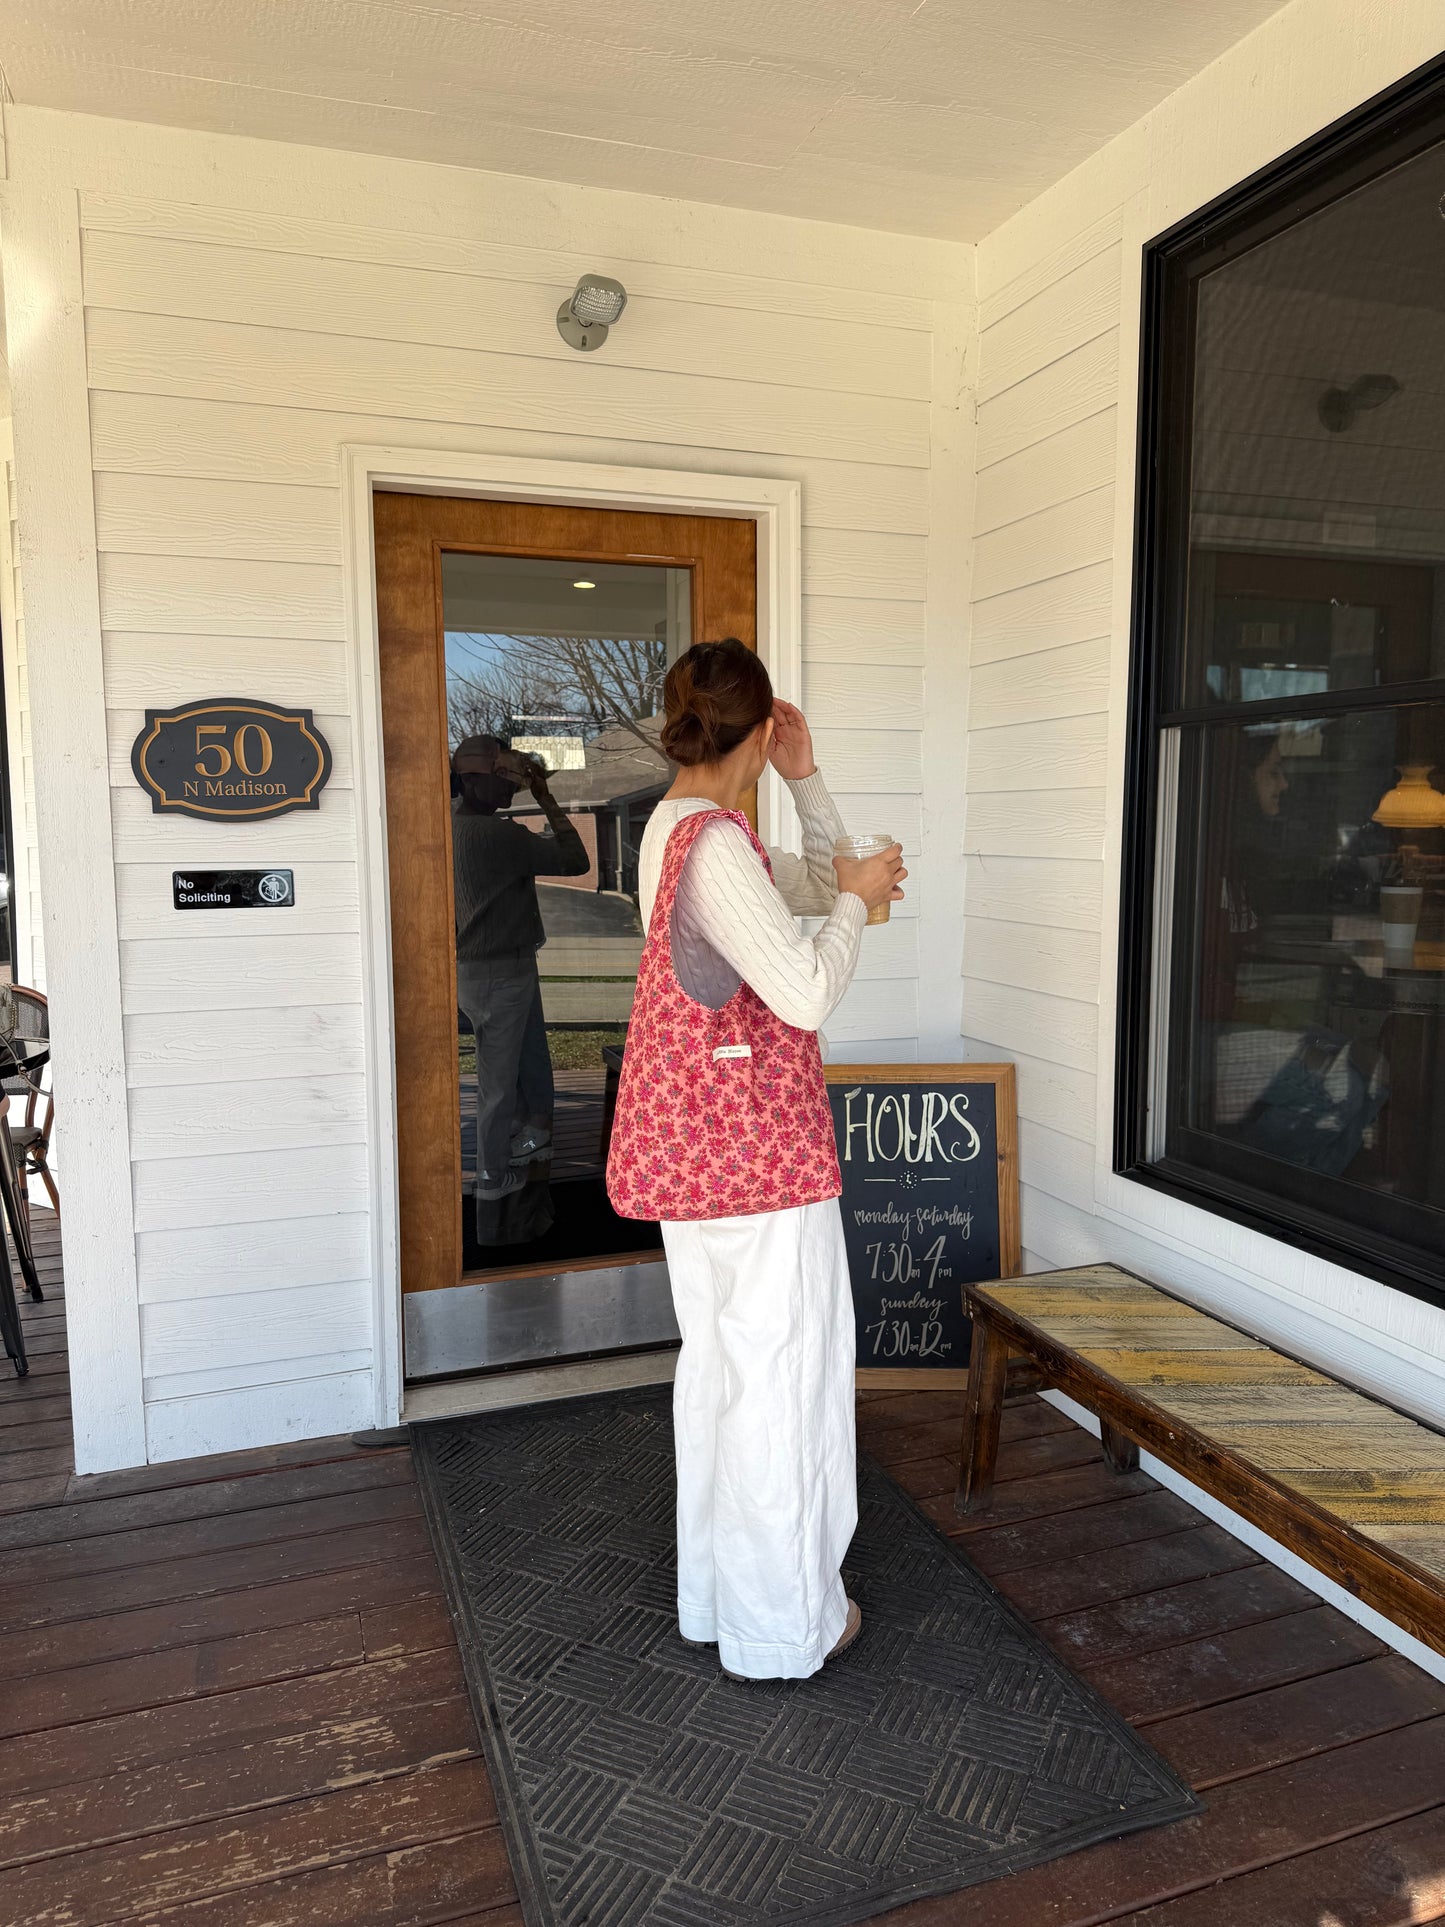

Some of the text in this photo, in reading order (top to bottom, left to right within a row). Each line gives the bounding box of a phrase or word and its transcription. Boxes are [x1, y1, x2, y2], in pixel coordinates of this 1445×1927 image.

[194, 723, 273, 777] 50
[183, 780, 287, 797] N Madison
[178, 879, 194, 889] No
[178, 892, 231, 904] Soliciting
[844, 1088, 981, 1163] HOURS
[881, 1291, 948, 1320] sunday
